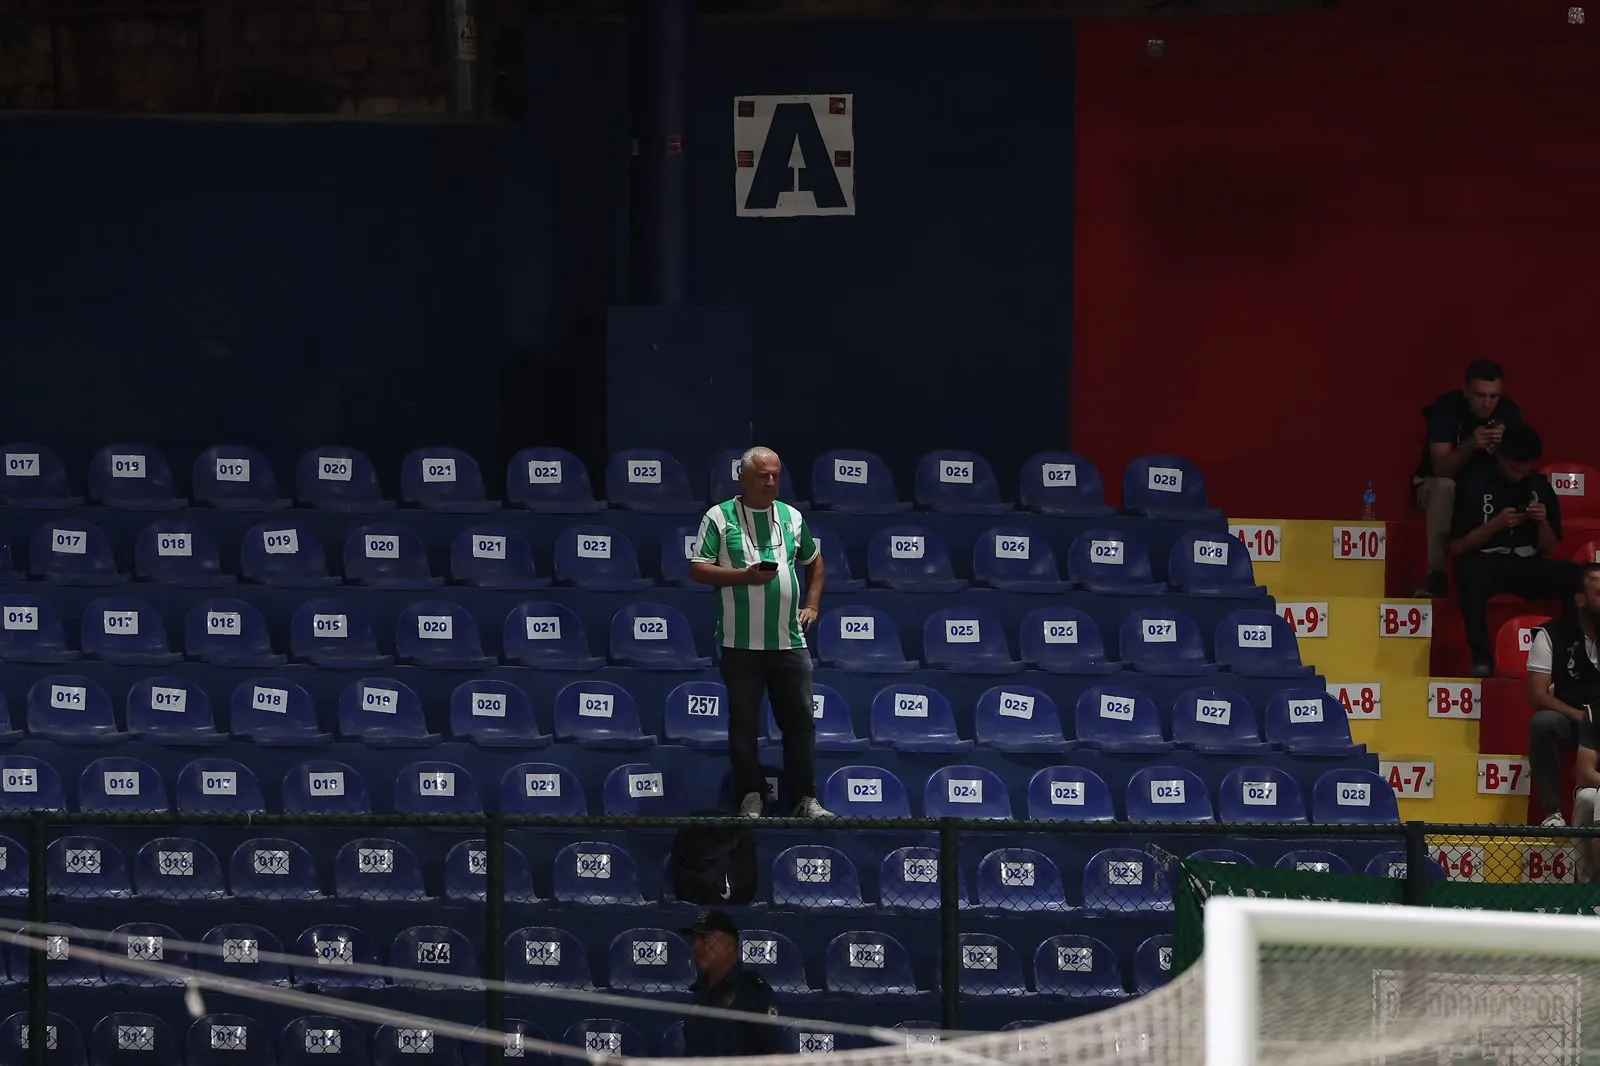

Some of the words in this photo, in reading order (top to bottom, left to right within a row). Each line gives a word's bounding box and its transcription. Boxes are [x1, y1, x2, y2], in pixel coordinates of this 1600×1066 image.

[744, 103, 847, 209] A
[11, 460, 33, 469] 017
[324, 464, 346, 474] 020
[220, 465, 242, 475] 019
[429, 465, 450, 475] 021
[535, 467, 557, 477] 022
[634, 467, 656, 477] 023
[839, 466, 861, 476] 025
[946, 467, 968, 477] 026
[1048, 471, 1071, 480] 027
[1154, 474, 1176, 485] 028
[57, 535, 80, 546] 017
[162, 539, 185, 549] 018
[268, 536, 290, 546] 019
[1341, 530, 1379, 557] B-10
[371, 541, 393, 551] 020
[479, 541, 500, 551] 021
[583, 541, 606, 551] 022
[896, 541, 918, 551] 025
[1002, 541, 1025, 551] 026
[109, 617, 132, 627] 017
[1283, 606, 1319, 633] A-9
[1385, 608, 1421, 635] B-9
[424, 622, 447, 632] 020
[534, 623, 555, 632] 021
[640, 623, 663, 632] 022
[846, 622, 869, 632] 024
[951, 626, 973, 635] 025
[1050, 627, 1073, 636] 026
[1148, 625, 1171, 635] 027
[156, 693, 180, 704] 017
[258, 693, 280, 705] 018
[1338, 687, 1374, 714] A-8
[1436, 687, 1473, 714] B-8
[477, 699, 500, 710] 020
[586, 700, 608, 711] 021
[691, 697, 717, 714] 257
[900, 700, 922, 710] 024
[1005, 699, 1028, 711] 025
[1107, 702, 1130, 713] 026
[1202, 706, 1226, 717] 027
[9, 776, 32, 785] 015
[1389, 765, 1426, 793] A-7
[1485, 763, 1523, 791] B-7
[110, 779, 133, 788] 016
[854, 785, 877, 795] 023
[1055, 788, 1078, 798] 025
[258, 856, 283, 866] 017
[472, 857, 486, 867] 01
[1436, 851, 1473, 878] A-6
[1529, 852, 1566, 879] B-6
[404, 1036, 426, 1046] 01
